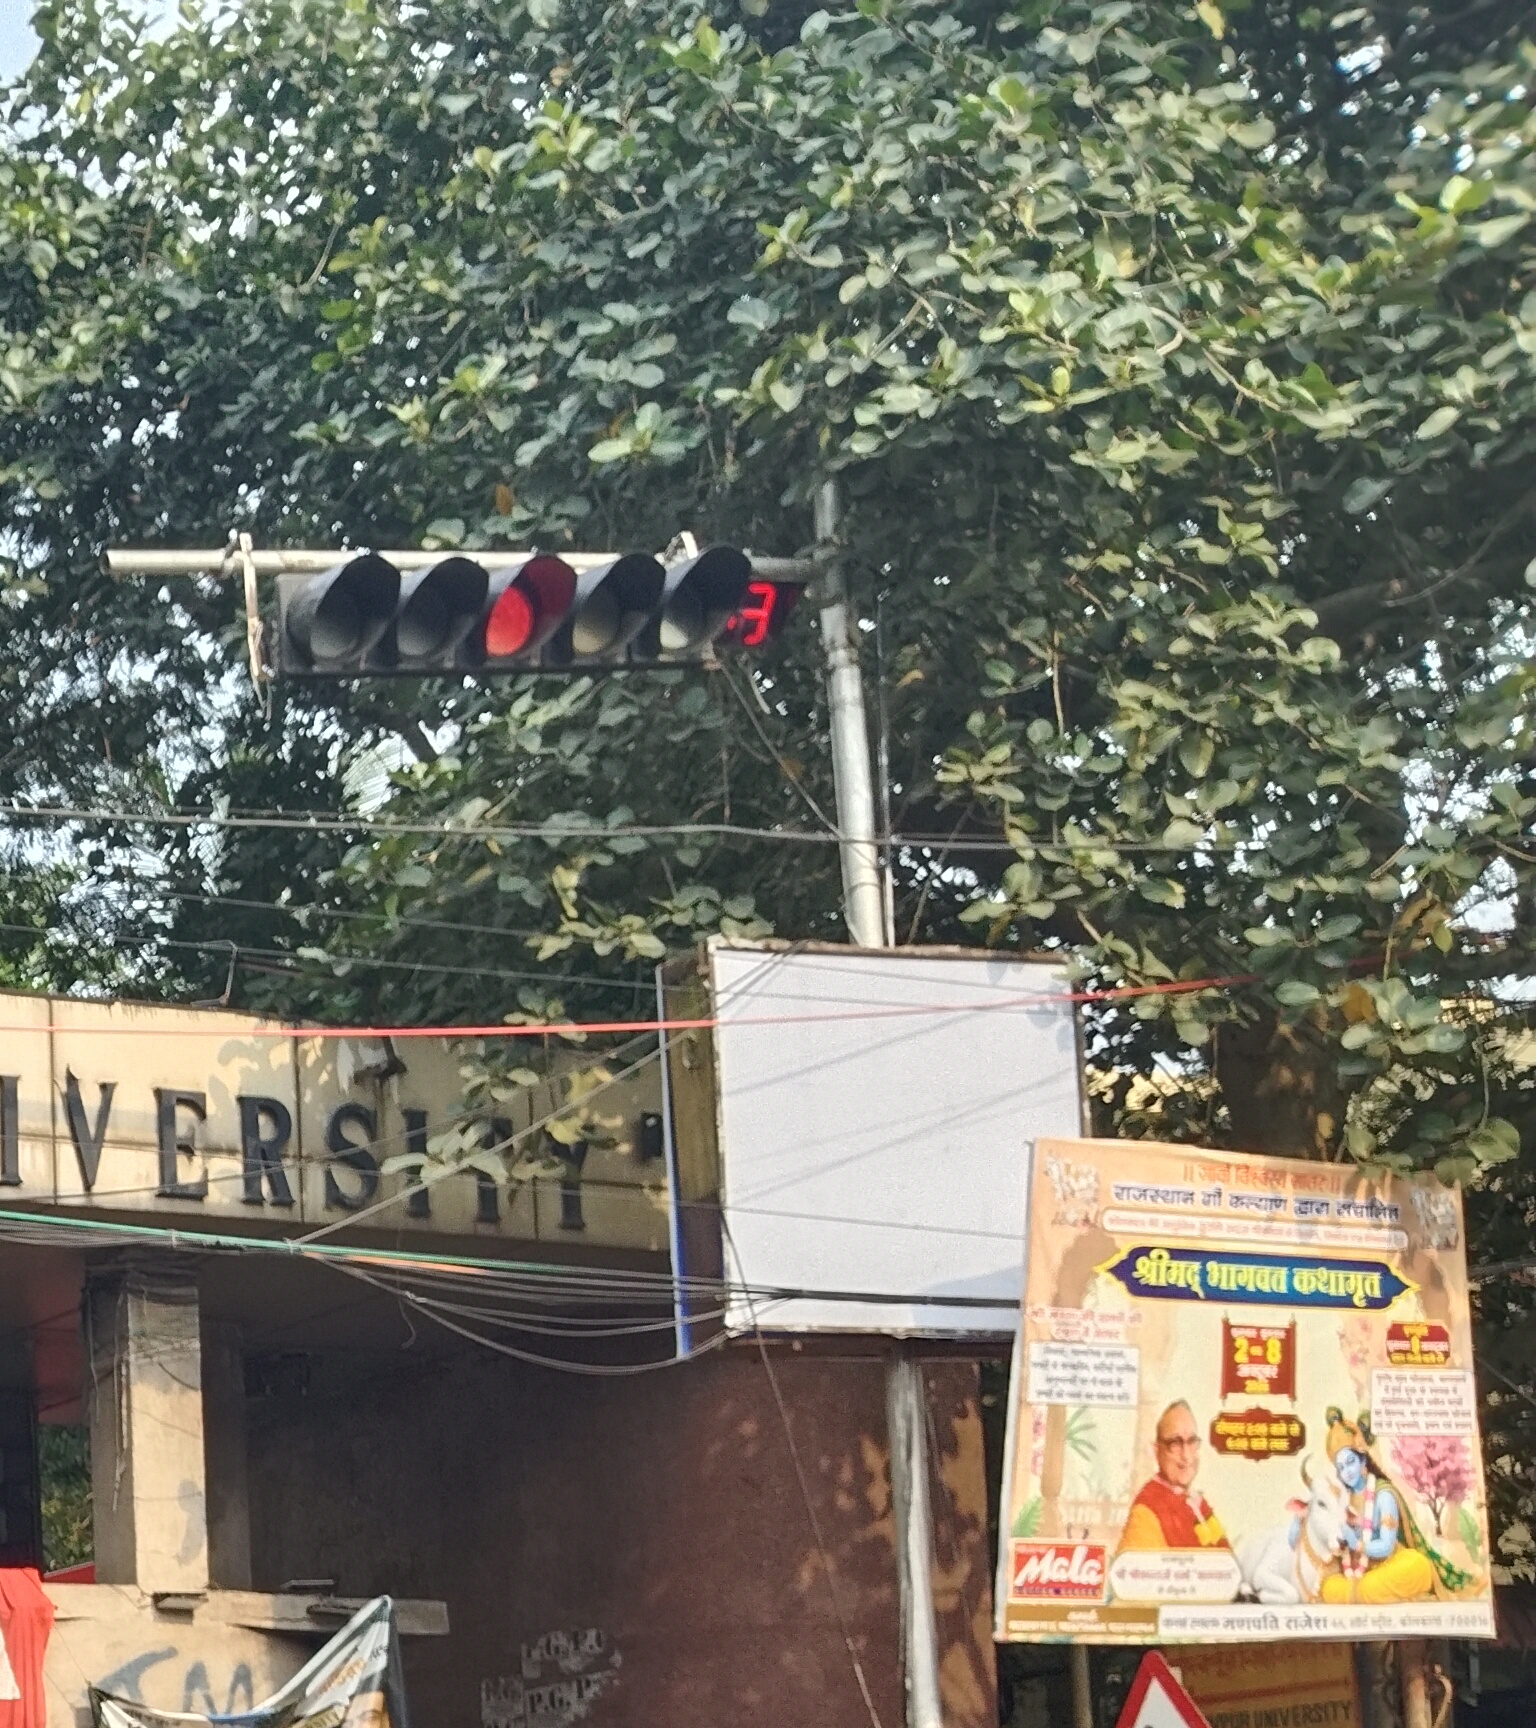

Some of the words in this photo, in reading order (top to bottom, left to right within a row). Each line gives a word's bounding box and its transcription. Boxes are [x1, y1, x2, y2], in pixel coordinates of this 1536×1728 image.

[1132, 1248, 1206, 1299] श्रीमद्
[1206, 1259, 1289, 1295] भागवत
[1292, 1266, 1383, 1308] कथामृत
[1014, 1545, 1104, 1586] Mala
